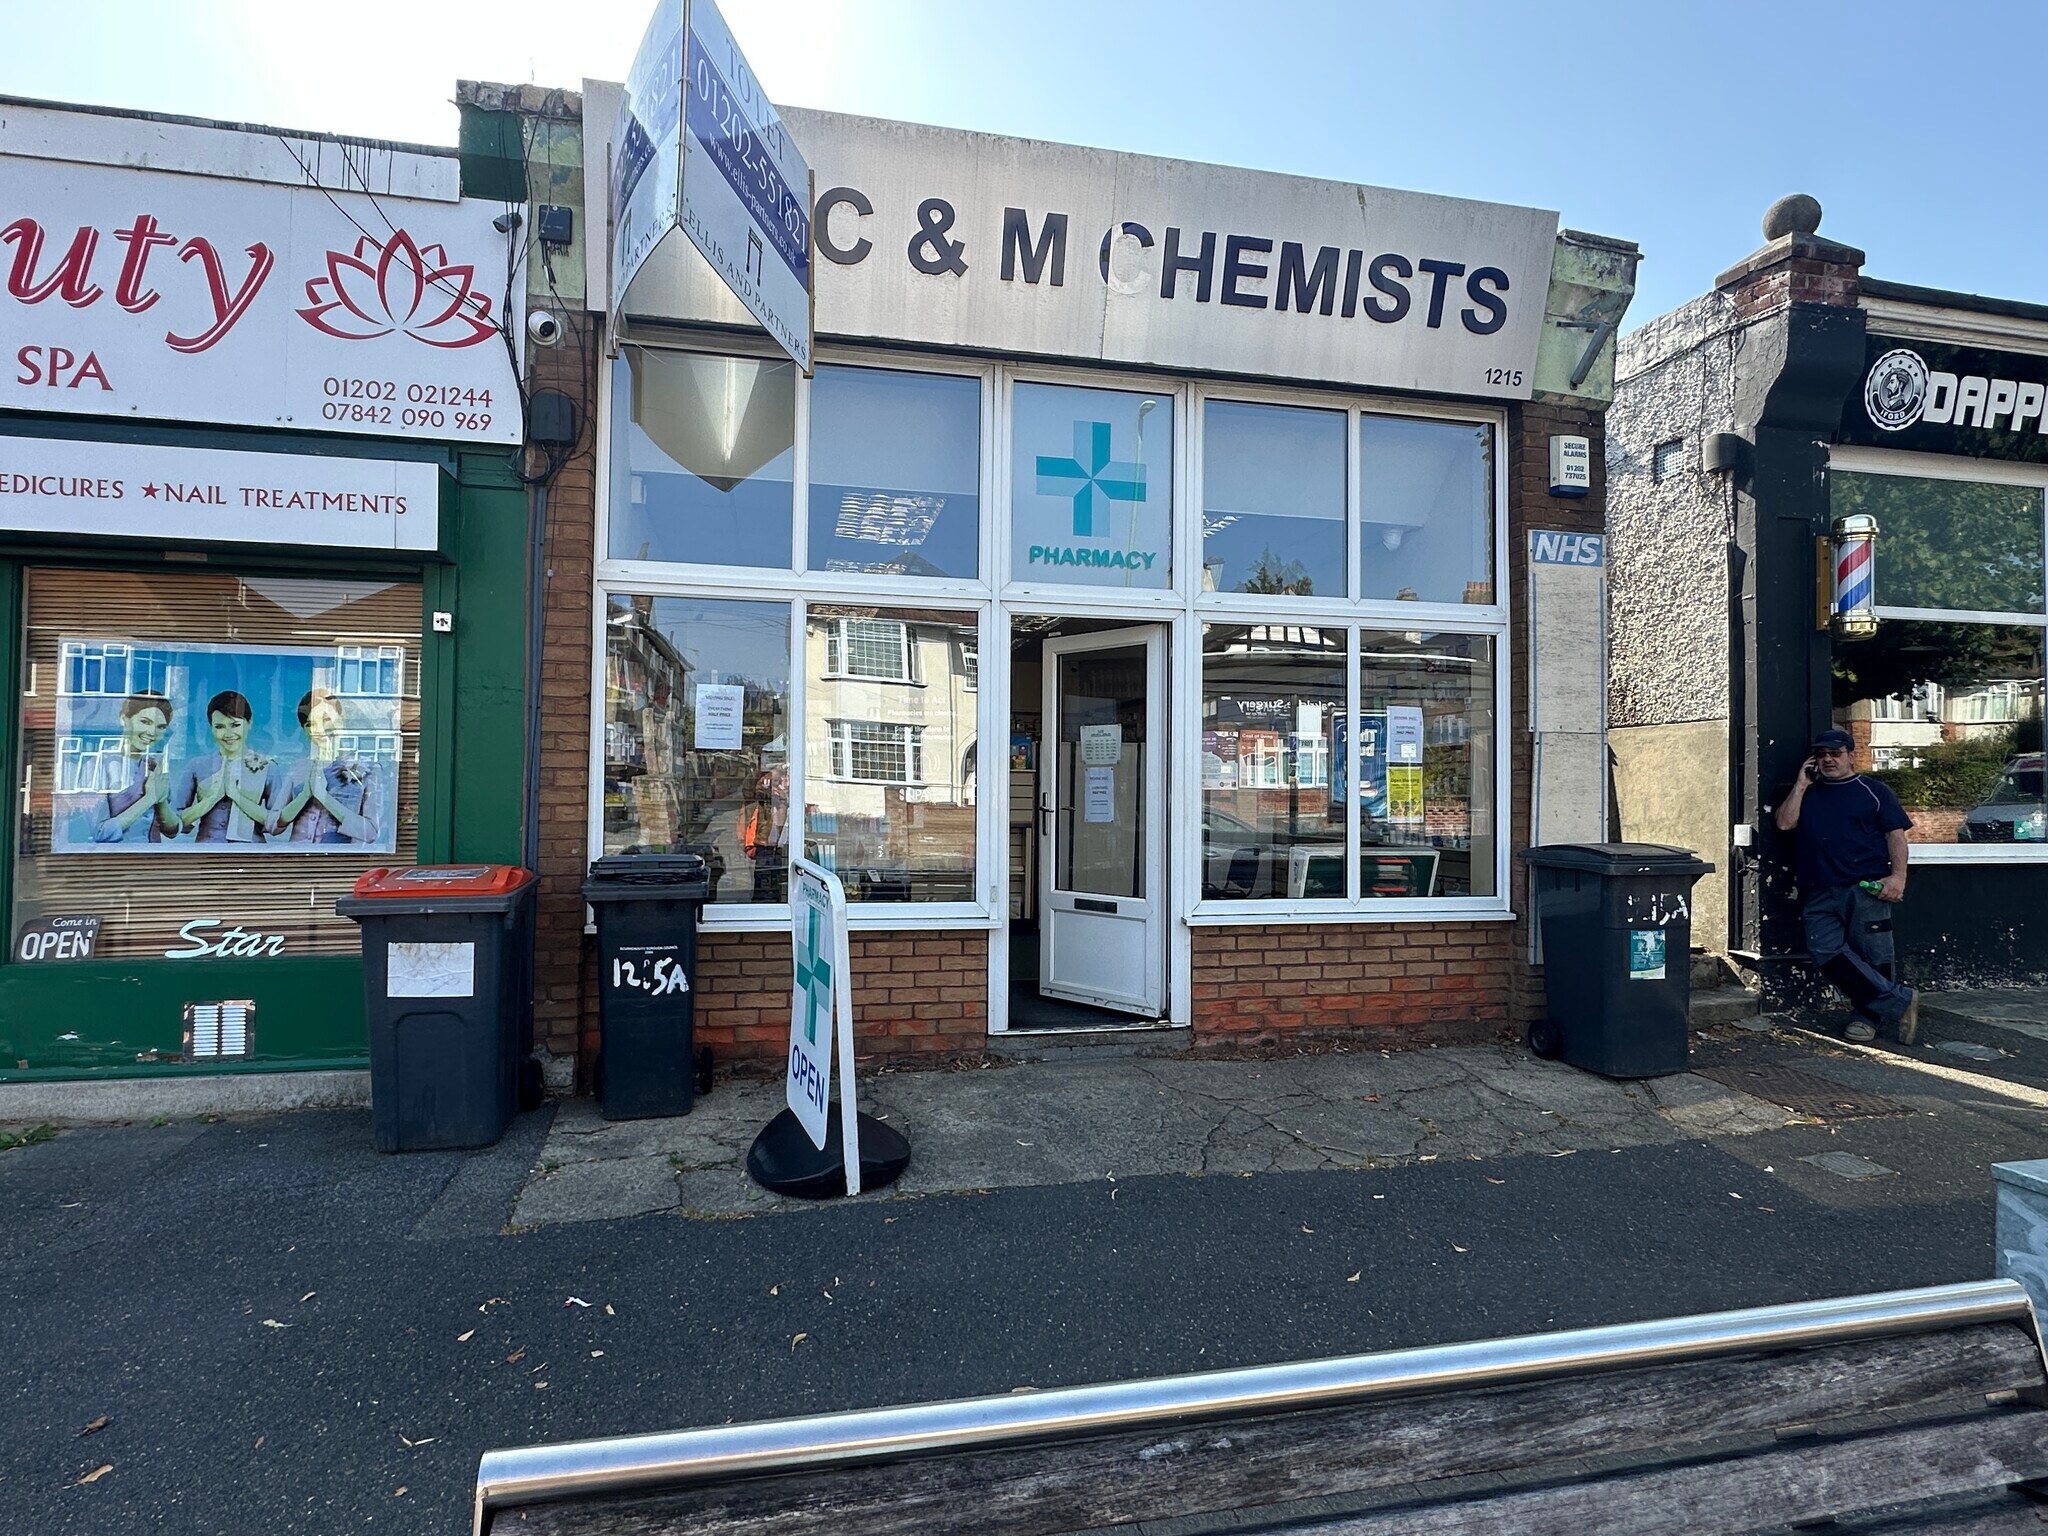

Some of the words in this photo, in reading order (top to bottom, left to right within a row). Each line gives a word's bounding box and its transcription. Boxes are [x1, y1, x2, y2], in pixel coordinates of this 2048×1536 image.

[697, 58, 808, 256] 01202-551821
[709, 131, 798, 267] www.ellis-partners.co.uk
[813, 186, 873, 266] C
[906, 197, 970, 279] &
[1000, 206, 1068, 288] M
[1099, 221, 1511, 336] CHEMISTS
[688, 206, 724, 264] ELLIS
[726, 261, 752, 298] AND
[754, 289, 808, 361] PARTNERS
[16, 345, 114, 392] SPA
[1484, 366, 1524, 388] 1215
[323, 376, 397, 402] 01202
[406, 383, 494, 408] 021244
[1922, 370, 2048, 435] DAPP
[322, 402, 393, 426] 07842
[402, 408, 446, 428] 090
[454, 412, 493, 433] 969
[1880, 410, 1906, 420] IFORD
[1563, 450, 1587, 459] ALARMS
[1564, 442, 1586, 450] SECURE
[1564, 472, 1587, 480] 737025
[1566, 464, 1585, 473] 01202
[0, 474, 125, 501] EDICURES
[164, 483, 228, 508] NAIL
[239, 487, 408, 516] TREATMENTS
[1029, 545, 1157, 571] PHARMACY
[1534, 533, 1601, 564] NHS
[802, 881, 831, 913] PHARMACY
[52, 917, 82, 928] Come
[84, 917, 97, 926] in
[20, 929, 94, 960] OPEN
[164, 919, 286, 958] Star
[791, 1044, 826, 1115] OPEN
